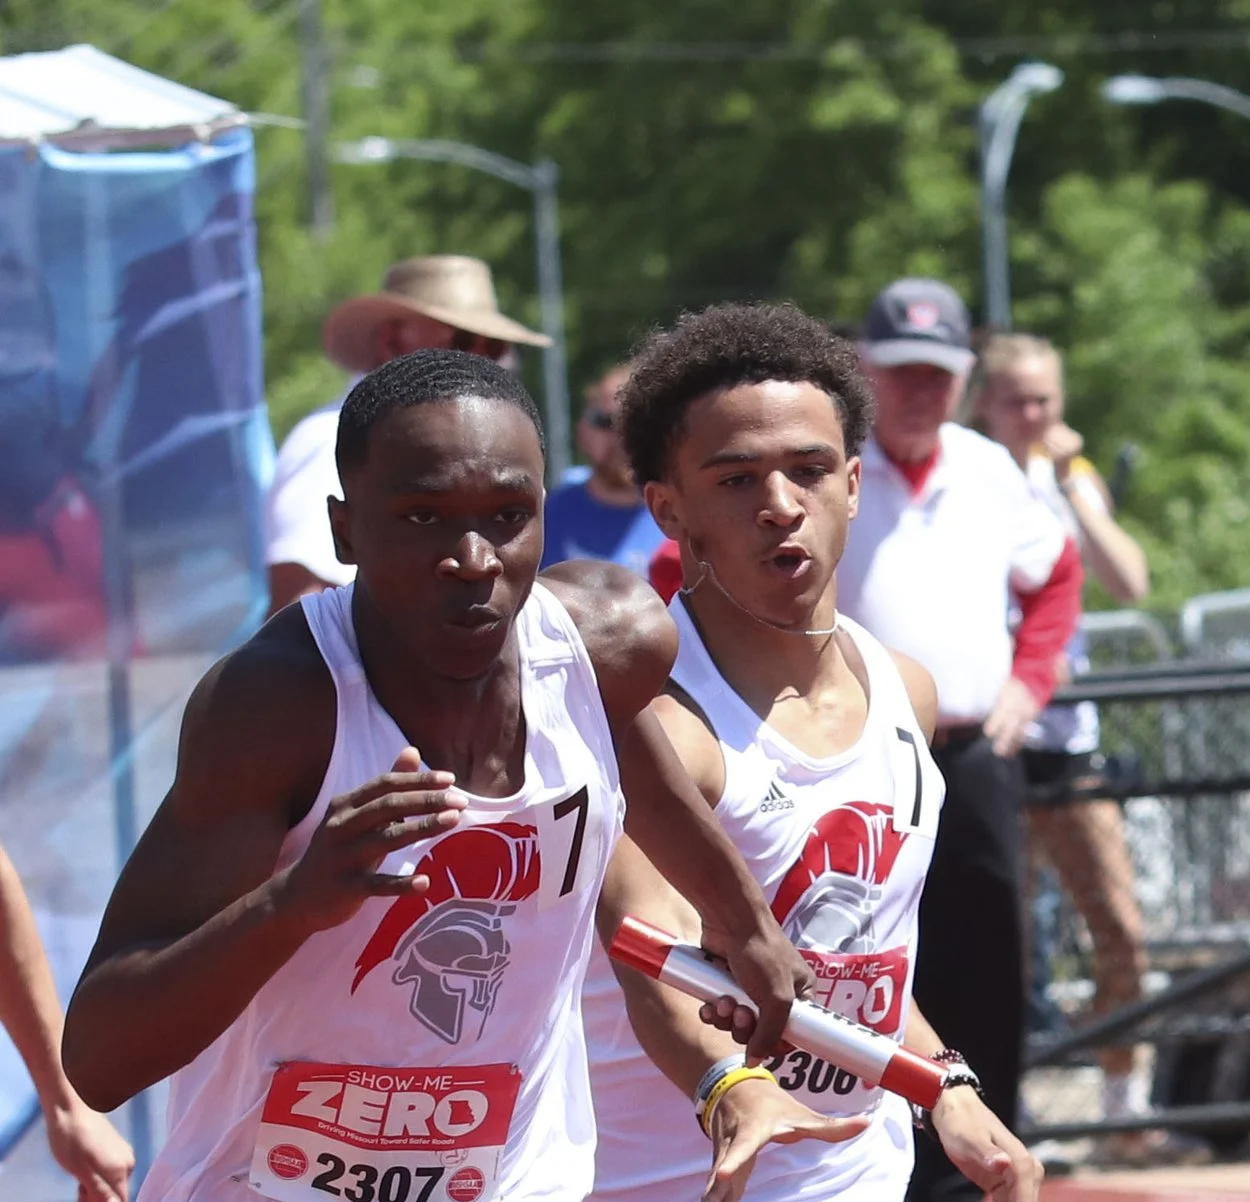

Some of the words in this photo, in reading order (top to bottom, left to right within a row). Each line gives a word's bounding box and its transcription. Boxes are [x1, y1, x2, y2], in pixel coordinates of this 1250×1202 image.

[895, 726, 922, 827] 7
[760, 799, 795, 813] adidas
[553, 784, 589, 898] 7
[805, 959, 881, 979] SHOW-ME
[815, 975, 895, 1025] RO
[347, 1070, 453, 1092] SHOW-ME
[762, 1050, 858, 1096] 306
[290, 1081, 489, 1138] ZERO
[317, 1121, 346, 1138] Driving
[346, 1130, 379, 1145] Missouri
[380, 1137, 409, 1146] Toward
